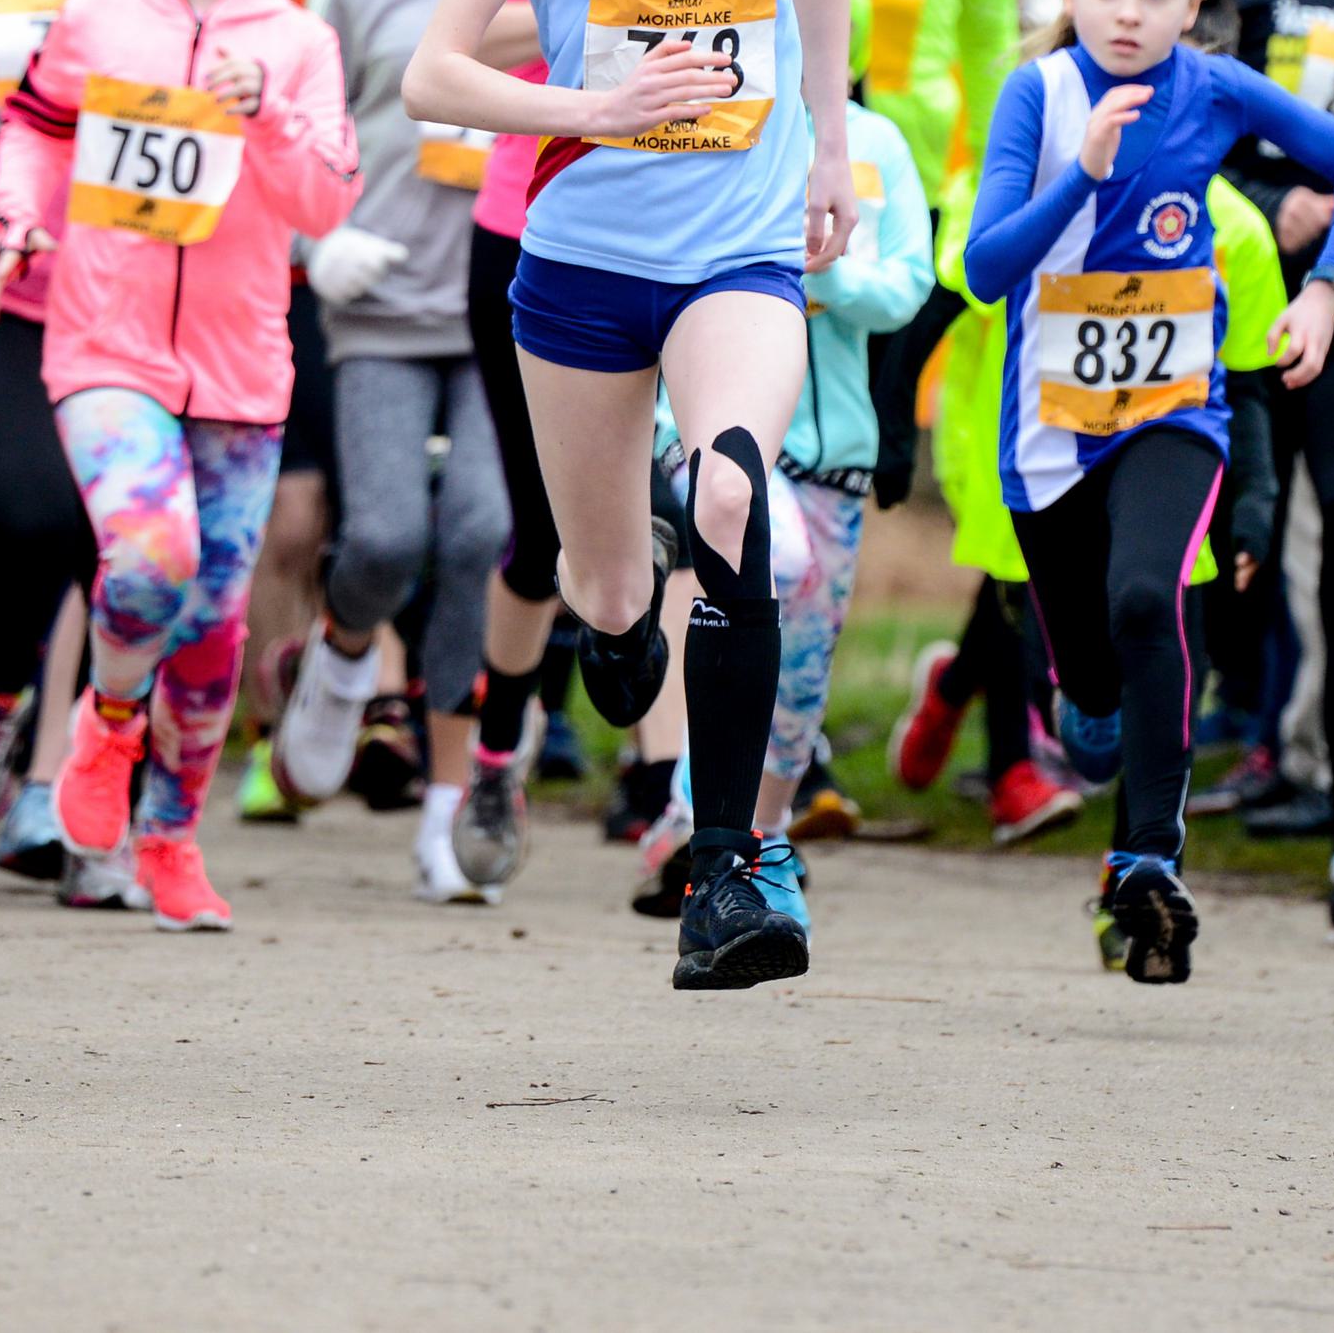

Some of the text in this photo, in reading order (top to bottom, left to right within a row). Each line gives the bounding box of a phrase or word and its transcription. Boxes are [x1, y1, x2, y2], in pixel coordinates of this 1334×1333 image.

[637, 10, 732, 27] MORNFLAKE
[627, 27, 745, 99] 78
[109, 125, 201, 195] 750
[633, 135, 732, 151] MORNFLAKE
[1073, 319, 1176, 385] 832
